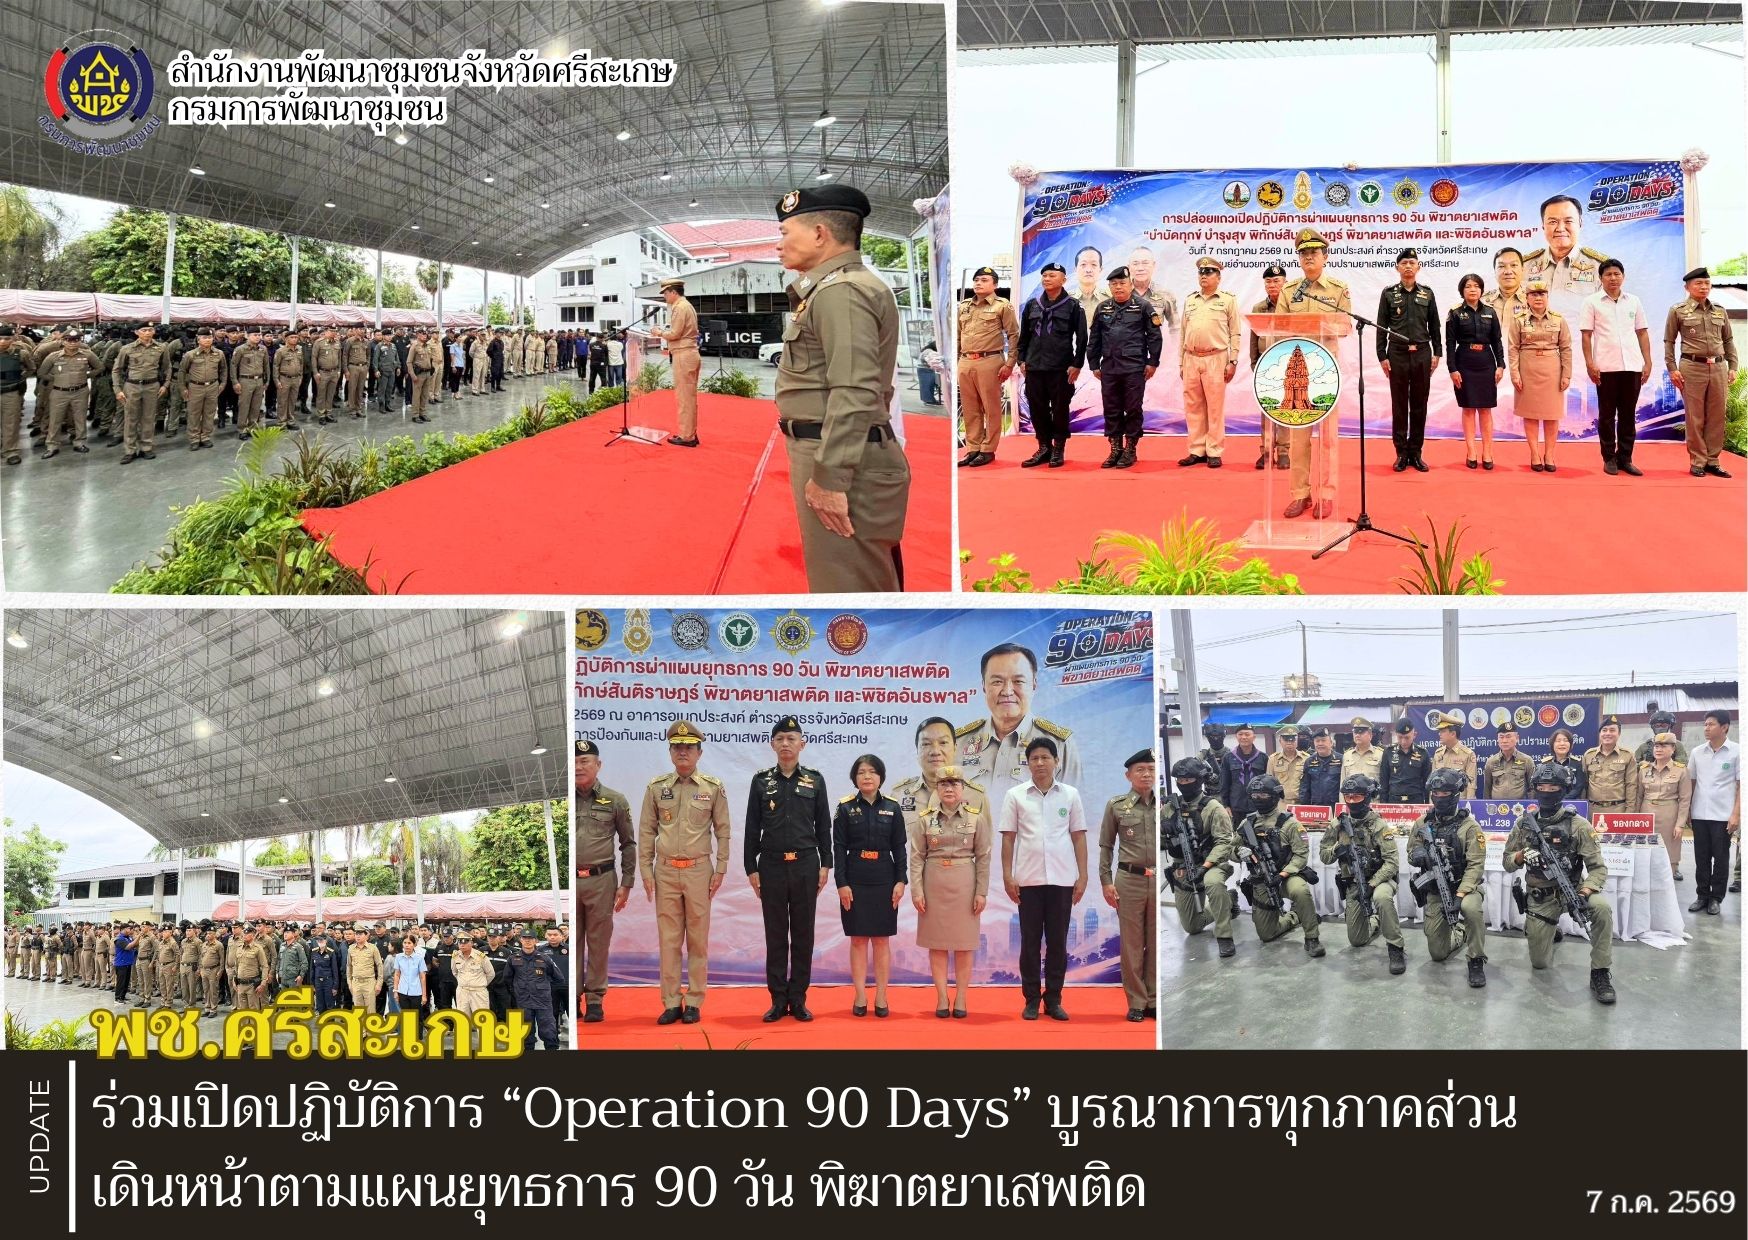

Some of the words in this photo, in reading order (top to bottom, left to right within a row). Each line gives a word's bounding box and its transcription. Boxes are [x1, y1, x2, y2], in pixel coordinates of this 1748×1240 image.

[1600, 171, 1652, 185] OPERATION
[1044, 181, 1088, 195] OPERATION
[1628, 180, 1674, 202] DAYS
[1032, 193, 1068, 217] 90
[1068, 189, 1106, 210] DAYS
[1588, 184, 1628, 210] 90
[1162, 211, 1389, 227] การปล่อยแถวเปิดปฏิบัติการผ่าแผนยุทธการ
[1392, 213, 1406, 223] 90
[1410, 211, 1425, 223] วัน
[1428, 210, 1518, 223] พิฆาตยาเสพติด
[1143, 229, 1202, 244] “บำบัดทุกข์
[1205, 229, 1246, 244] บำรุงสุข
[1346, 228, 1432, 241] พิฆาตยาเสพติด
[1435, 227, 1539, 240] และพิชิตอันธพาล”
[1188, 243, 1206, 255] วันที่
[1208, 247, 1215, 255] 7
[1216, 247, 1258, 256] กรกฎาคม
[1259, 247, 1282, 255] 2569
[1283, 247, 1293, 255] ณ
[704, 332, 762, 344] PLICE
[1063, 612, 1135, 631] OPERATION
[1045, 629, 1104, 665] 90
[772, 662, 794, 677] 90
[798, 660, 820, 678] วัน
[826, 661, 950, 679] พิฆาตยาเสพติด
[704, 684, 830, 703] พิฆาตยาเสพติด
[834, 686, 977, 704] และพิชิตอันธพาล”
[575, 709, 606, 721] 2569
[609, 711, 623, 721] ณ
[1495, 819, 1511, 827] 238
[1612, 819, 1650, 828] ของกลาง
